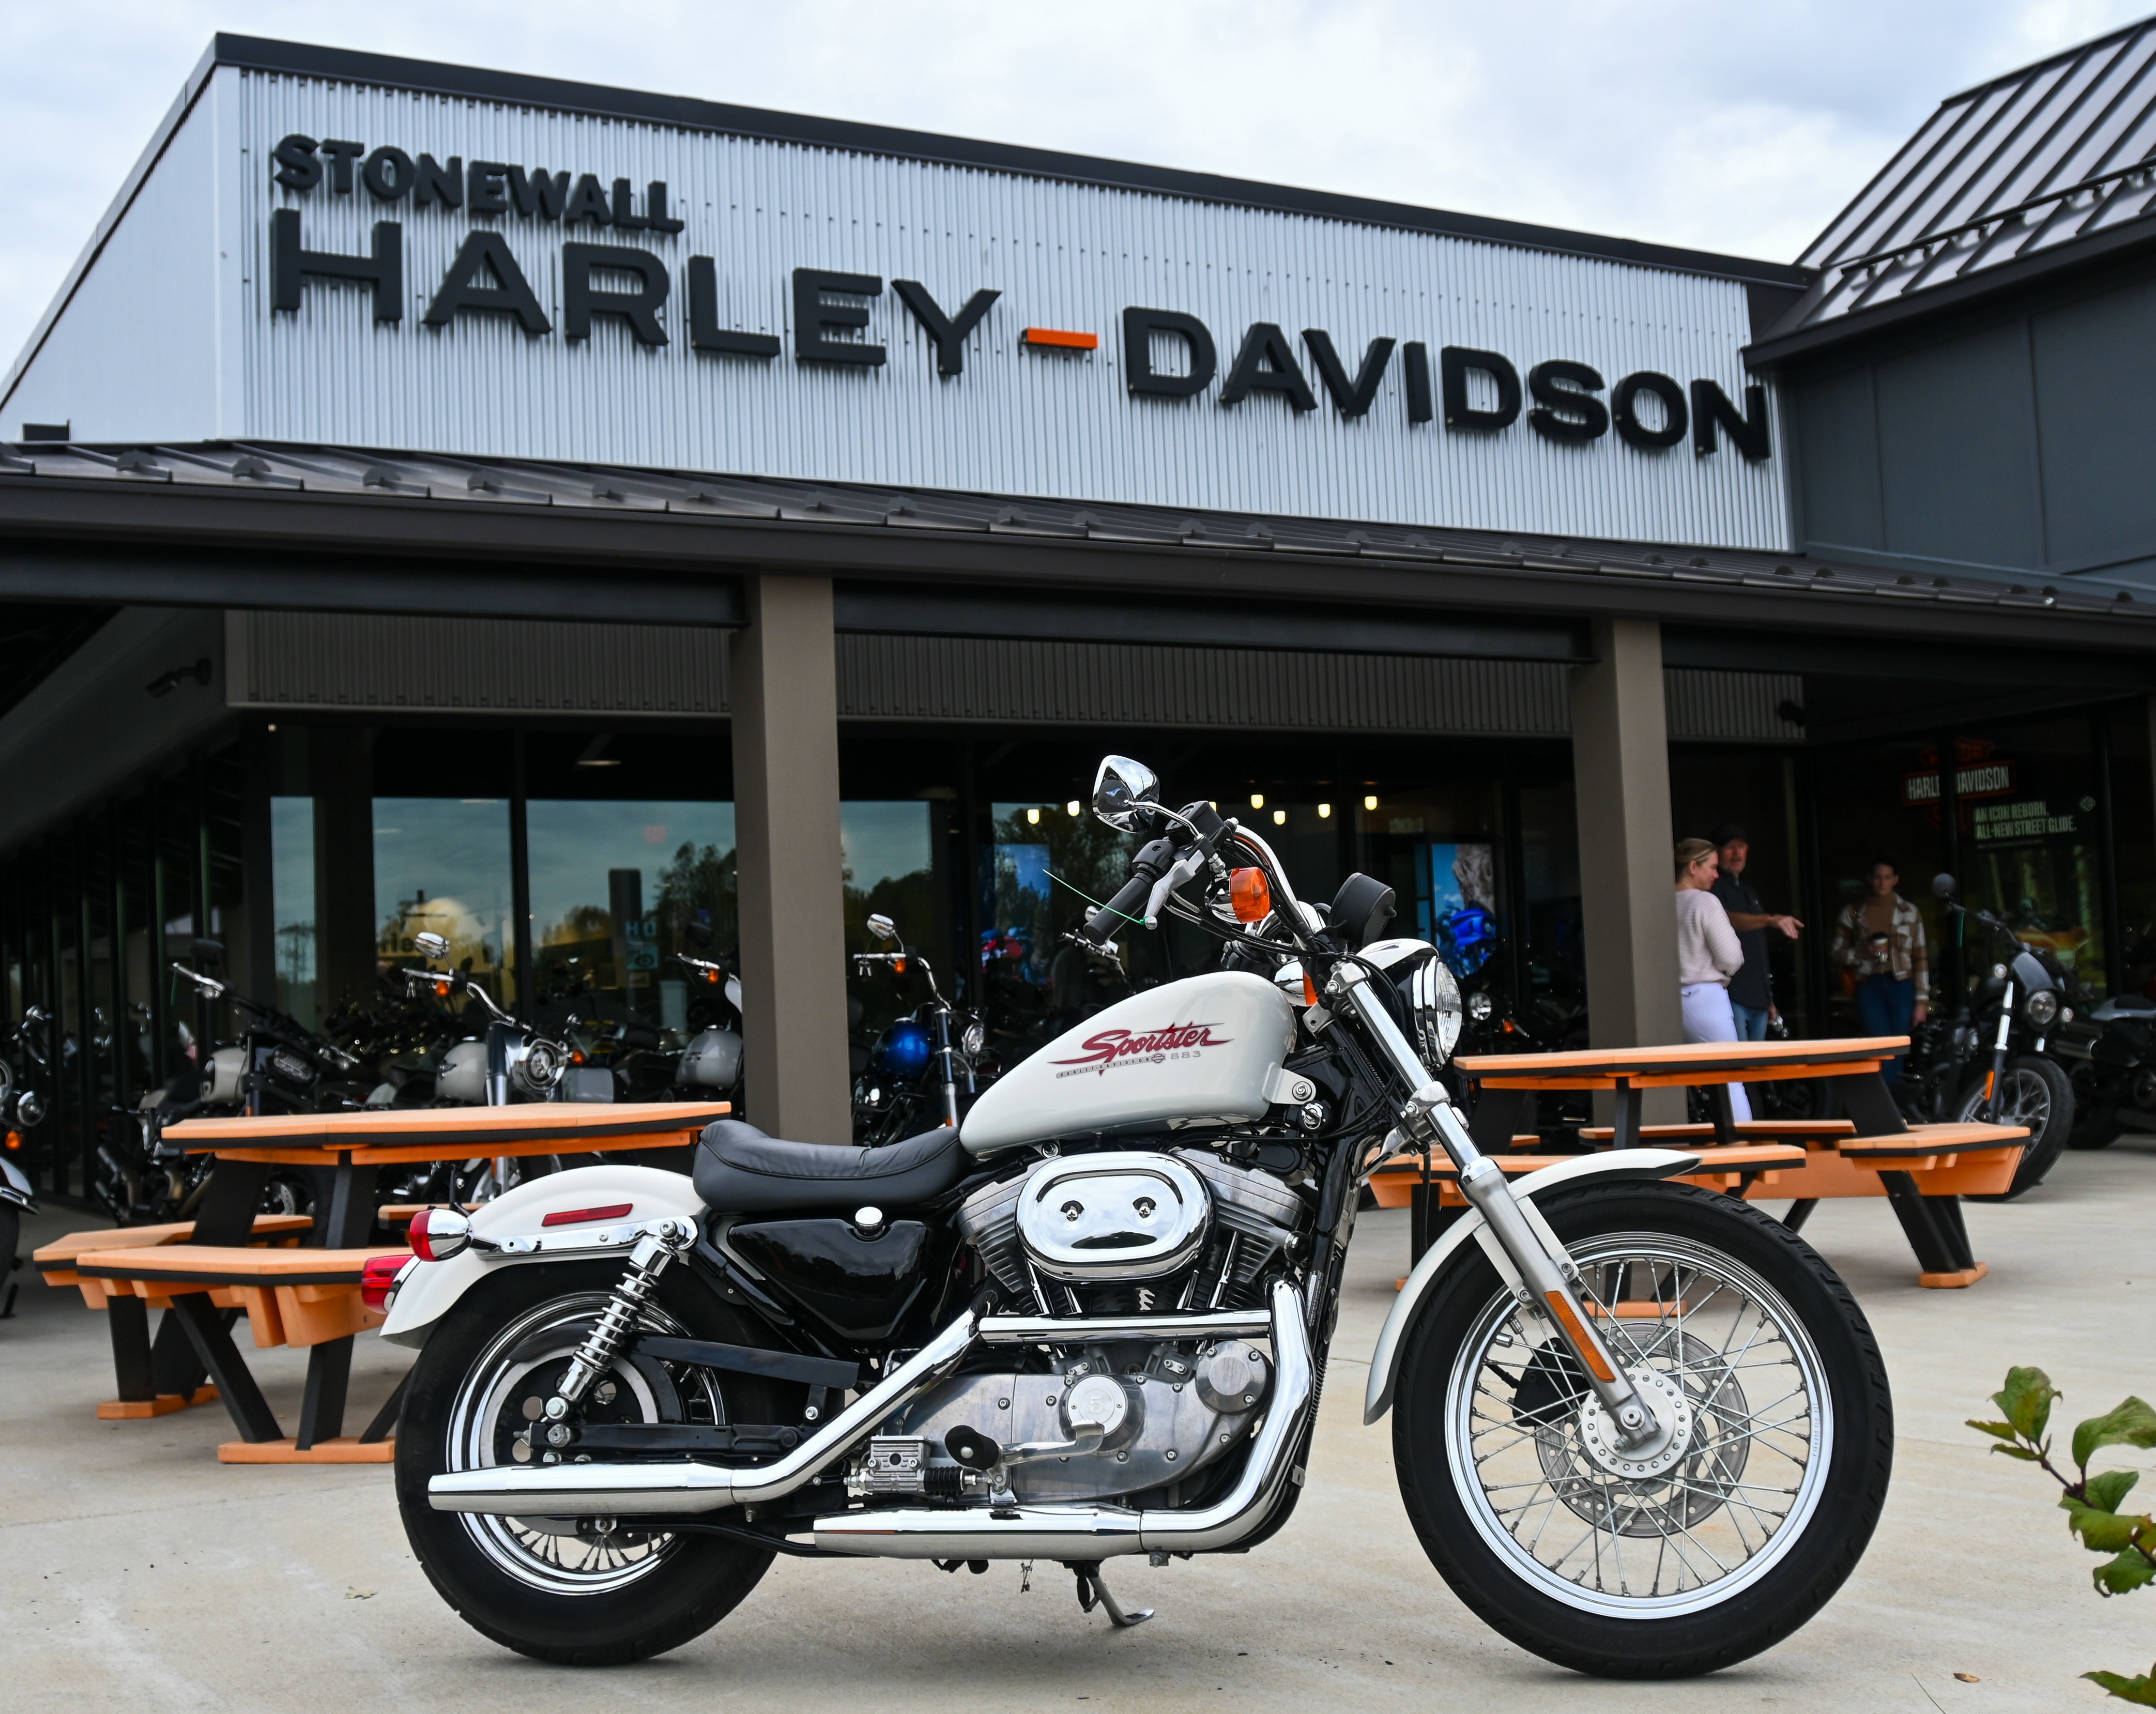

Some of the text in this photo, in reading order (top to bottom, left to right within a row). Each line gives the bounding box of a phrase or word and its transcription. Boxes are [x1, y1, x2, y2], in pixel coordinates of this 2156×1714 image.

[273, 133, 684, 234] STONEWALL
[1975, 807, 1987, 823] AN
[1989, 804, 2010, 821] ICON
[2011, 801, 2050, 818] REBORN.
[1976, 815, 2077, 840] ALL-NEW STREET GLIDE.
[1047, 1021, 1235, 1076] Sportster
[1170, 1050, 1201, 1060] 883
[1090, 1395, 1104, 1414] 5
